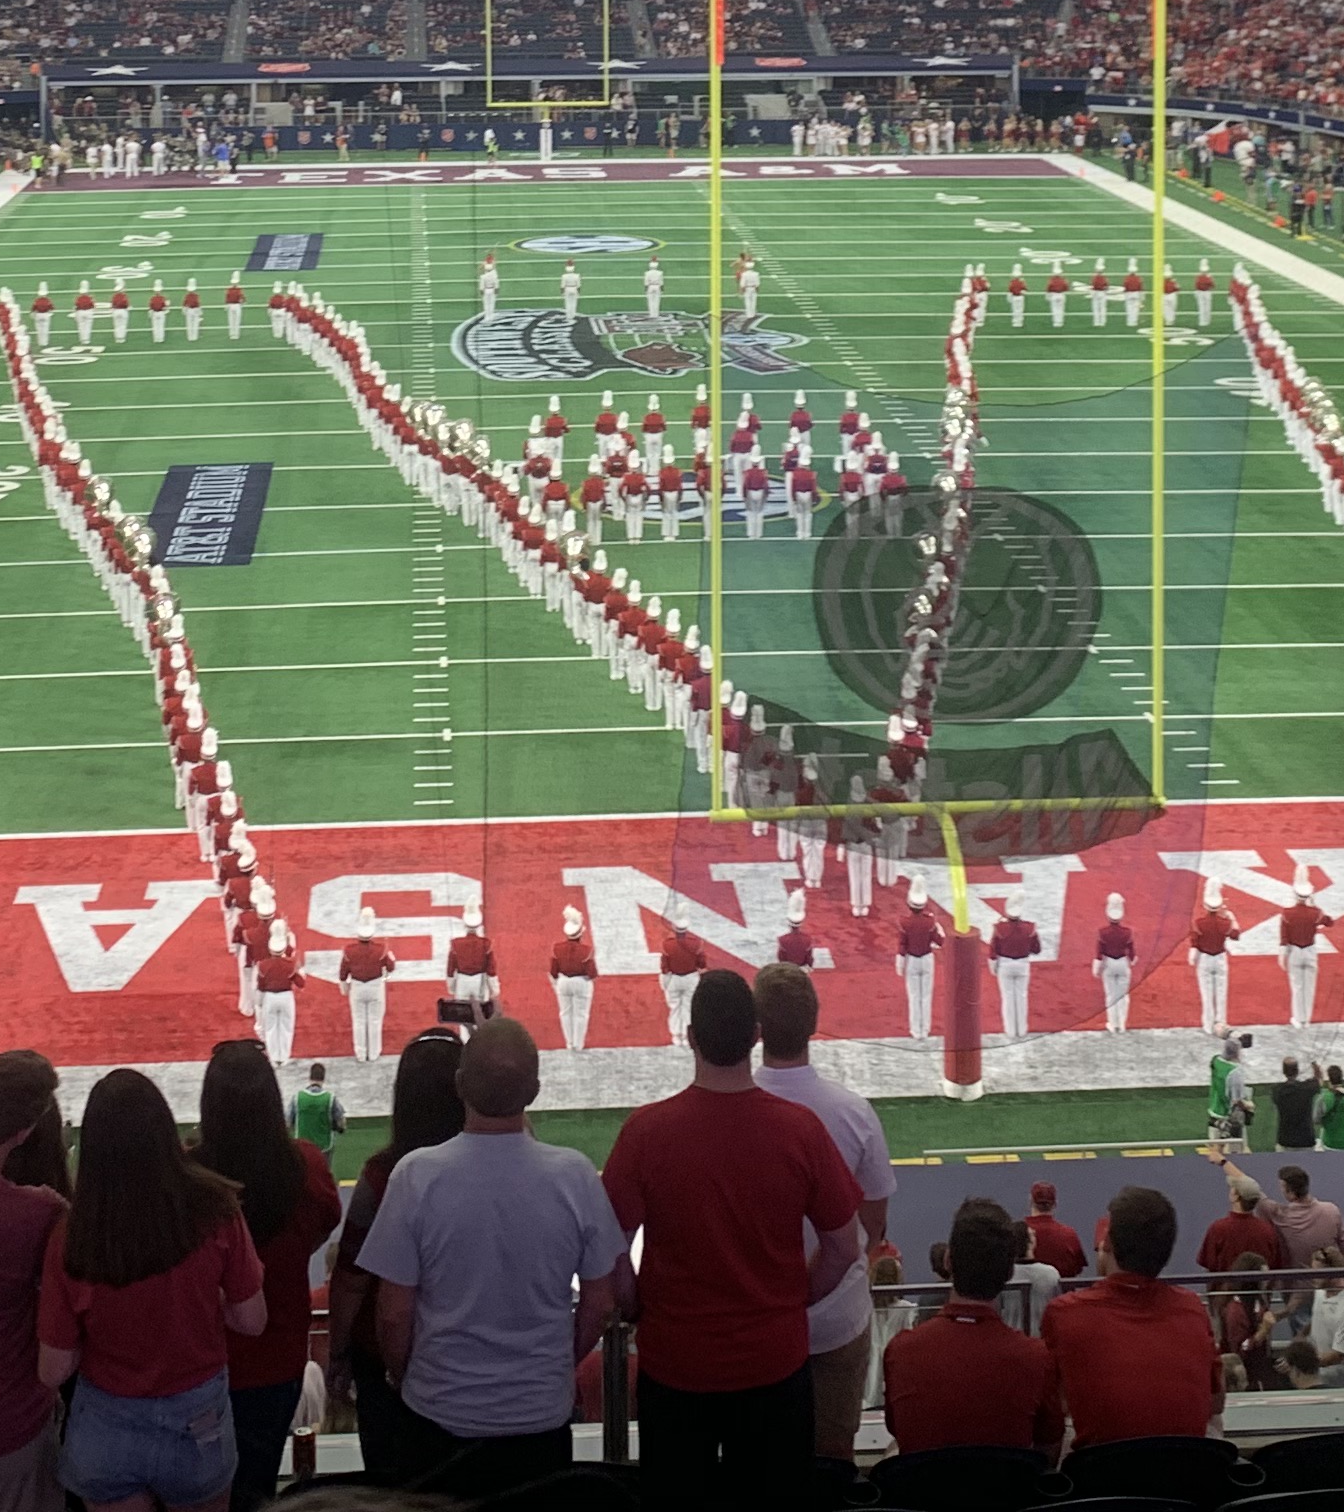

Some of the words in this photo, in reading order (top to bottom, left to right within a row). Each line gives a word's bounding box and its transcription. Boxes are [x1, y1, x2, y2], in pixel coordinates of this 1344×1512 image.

[209, 166, 609, 185] TEXAS
[668, 162, 913, 177] A&M
[467, 309, 571, 379] SOUTHWEST
[529, 317, 594, 368] CLASSIC
[177, 464, 250, 524] STADIUM
[163, 525, 233, 564] AT&T
